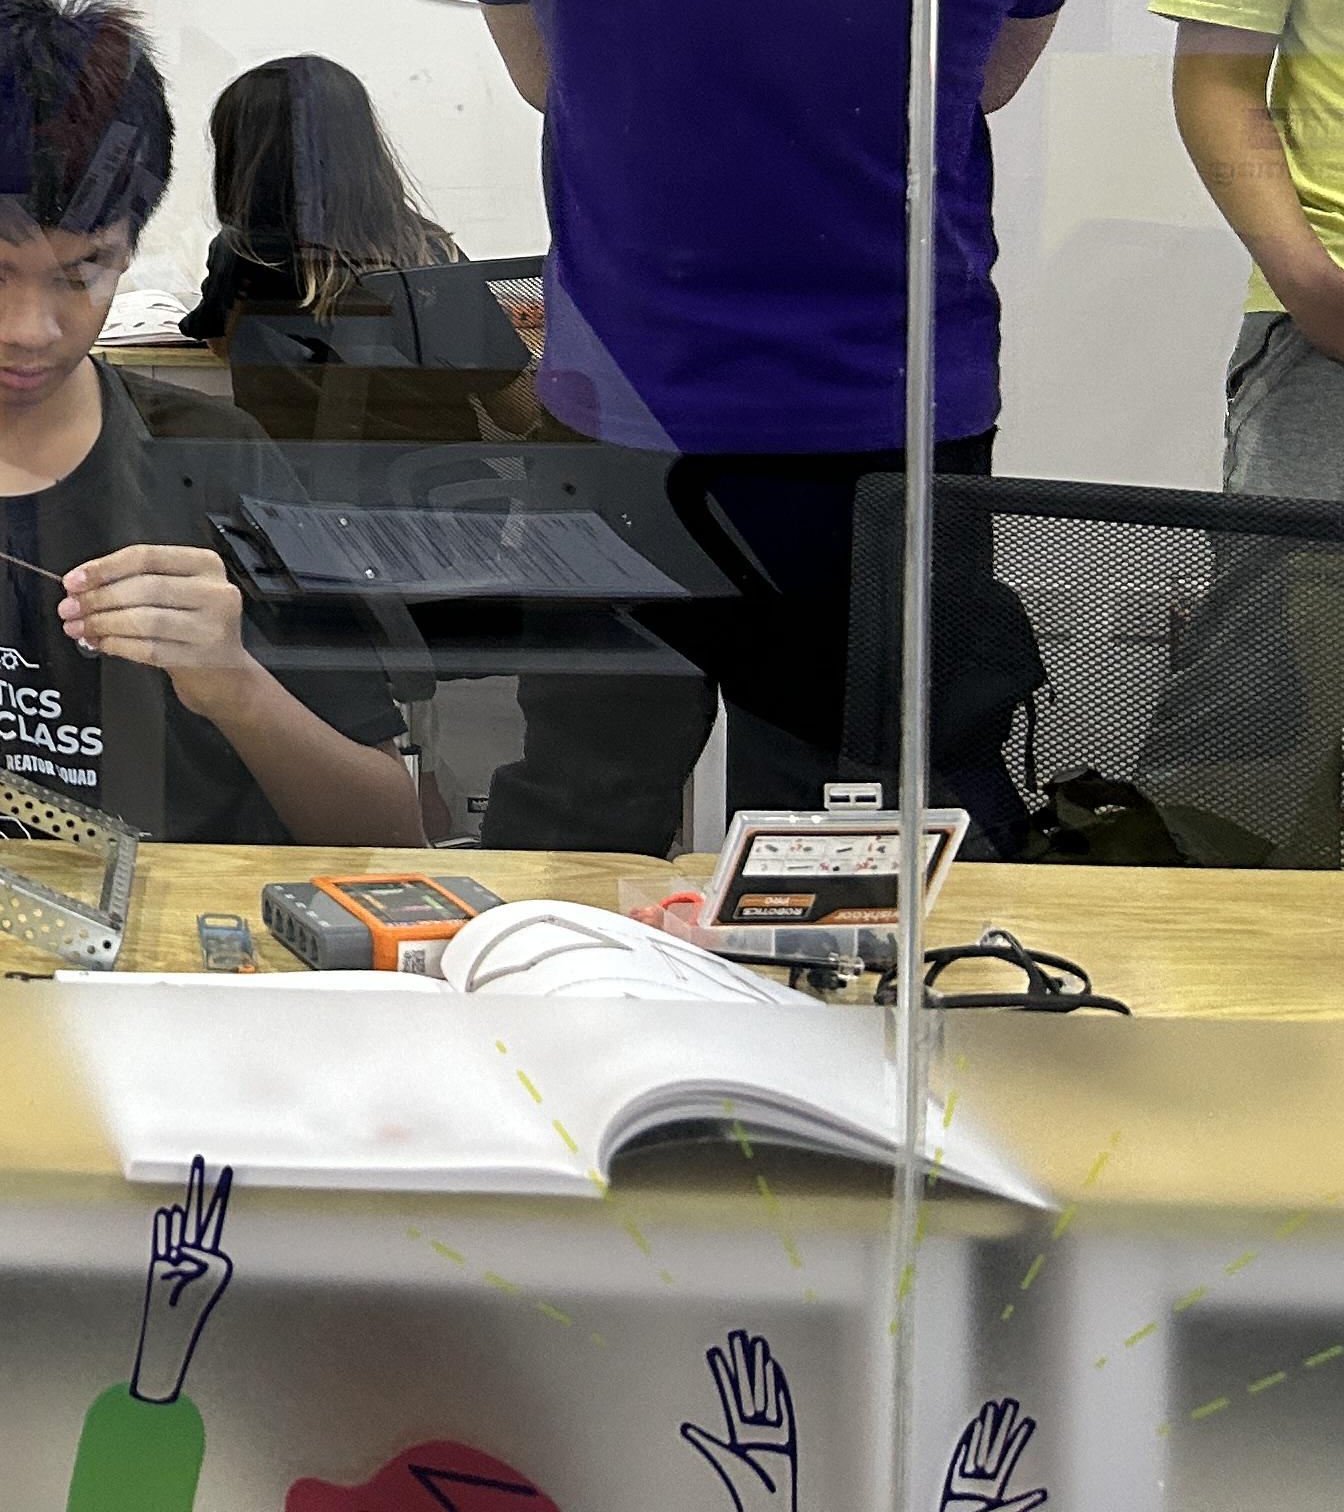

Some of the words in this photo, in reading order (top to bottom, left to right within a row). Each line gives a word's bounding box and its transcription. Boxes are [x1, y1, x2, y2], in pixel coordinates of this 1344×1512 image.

[6, 754, 55, 776] REATOR
[764, 896, 791, 906] PRO
[741, 908, 803, 917] ROBOTICS
